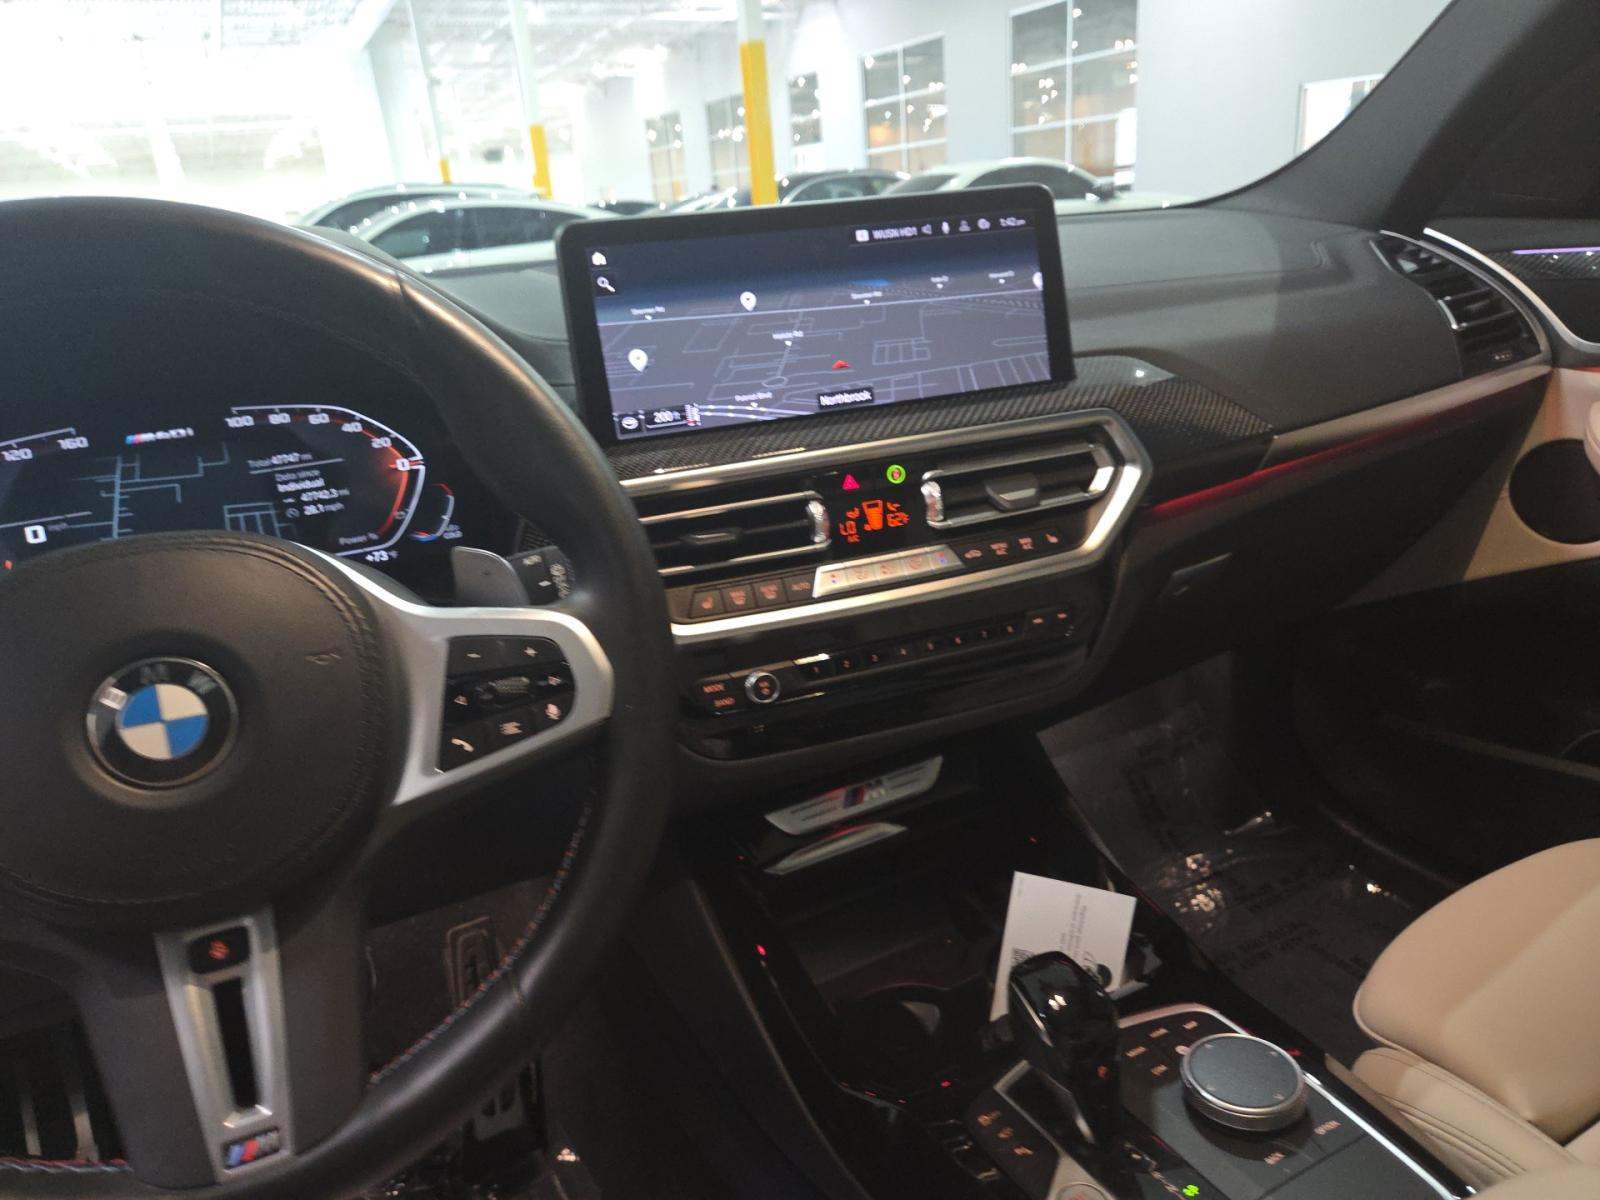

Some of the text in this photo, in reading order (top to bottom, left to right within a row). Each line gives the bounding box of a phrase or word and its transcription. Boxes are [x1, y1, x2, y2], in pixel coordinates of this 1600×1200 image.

[225, 415, 254, 428] 100
[268, 413, 291, 425] 80
[341, 421, 363, 433] 40
[57, 436, 89, 450] 160
[371, 437, 392, 449] 20
[1, 448, 33, 462] 120
[24, 525, 47, 544] 0
